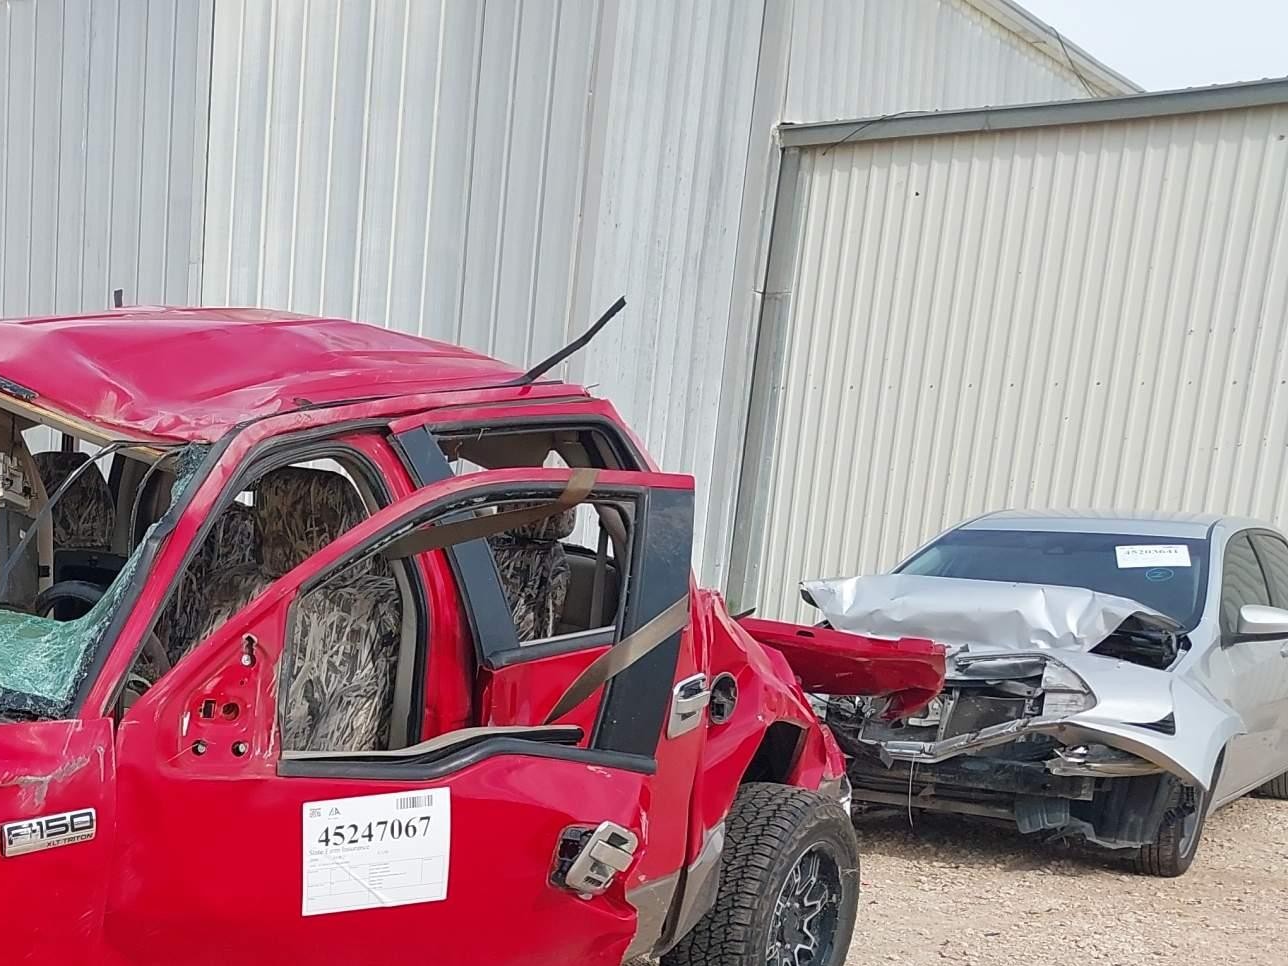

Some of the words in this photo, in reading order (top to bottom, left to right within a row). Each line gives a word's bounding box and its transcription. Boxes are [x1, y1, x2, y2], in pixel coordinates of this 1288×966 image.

[6, 811, 95, 846] F-150
[46, 838, 61, 847] XLT
[63, 832, 94, 844] TRITON
[317, 816, 431, 847] 45247067
